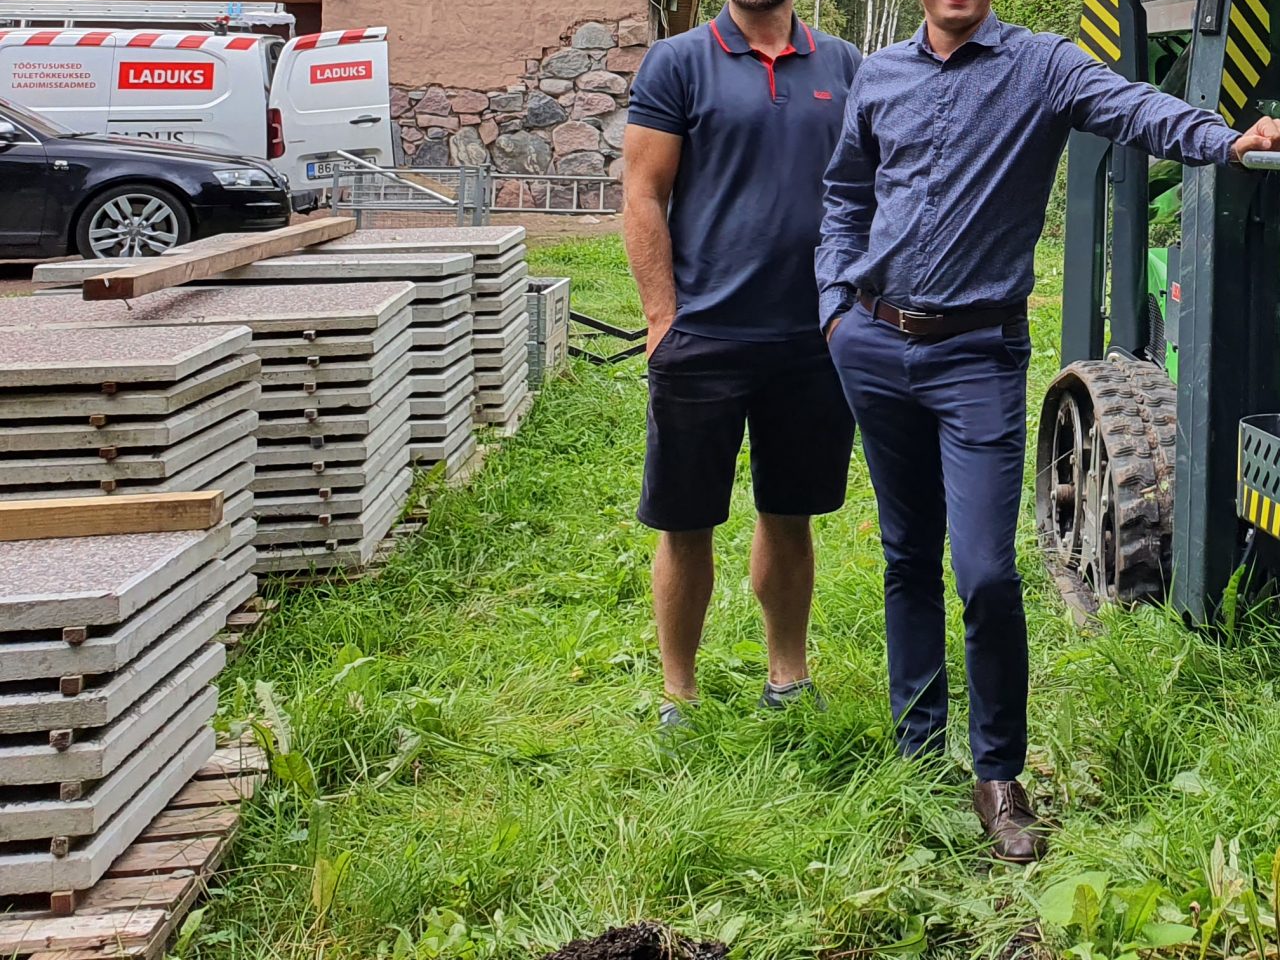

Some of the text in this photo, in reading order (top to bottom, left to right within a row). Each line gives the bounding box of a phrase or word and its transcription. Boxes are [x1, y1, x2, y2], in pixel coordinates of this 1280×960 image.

[12, 71, 91, 79] TULETÕKKEUKSED
[128, 69, 205, 84] LADUKS
[316, 65, 367, 80] LADUKS
[11, 81, 97, 89] LAADIMISSEADMED
